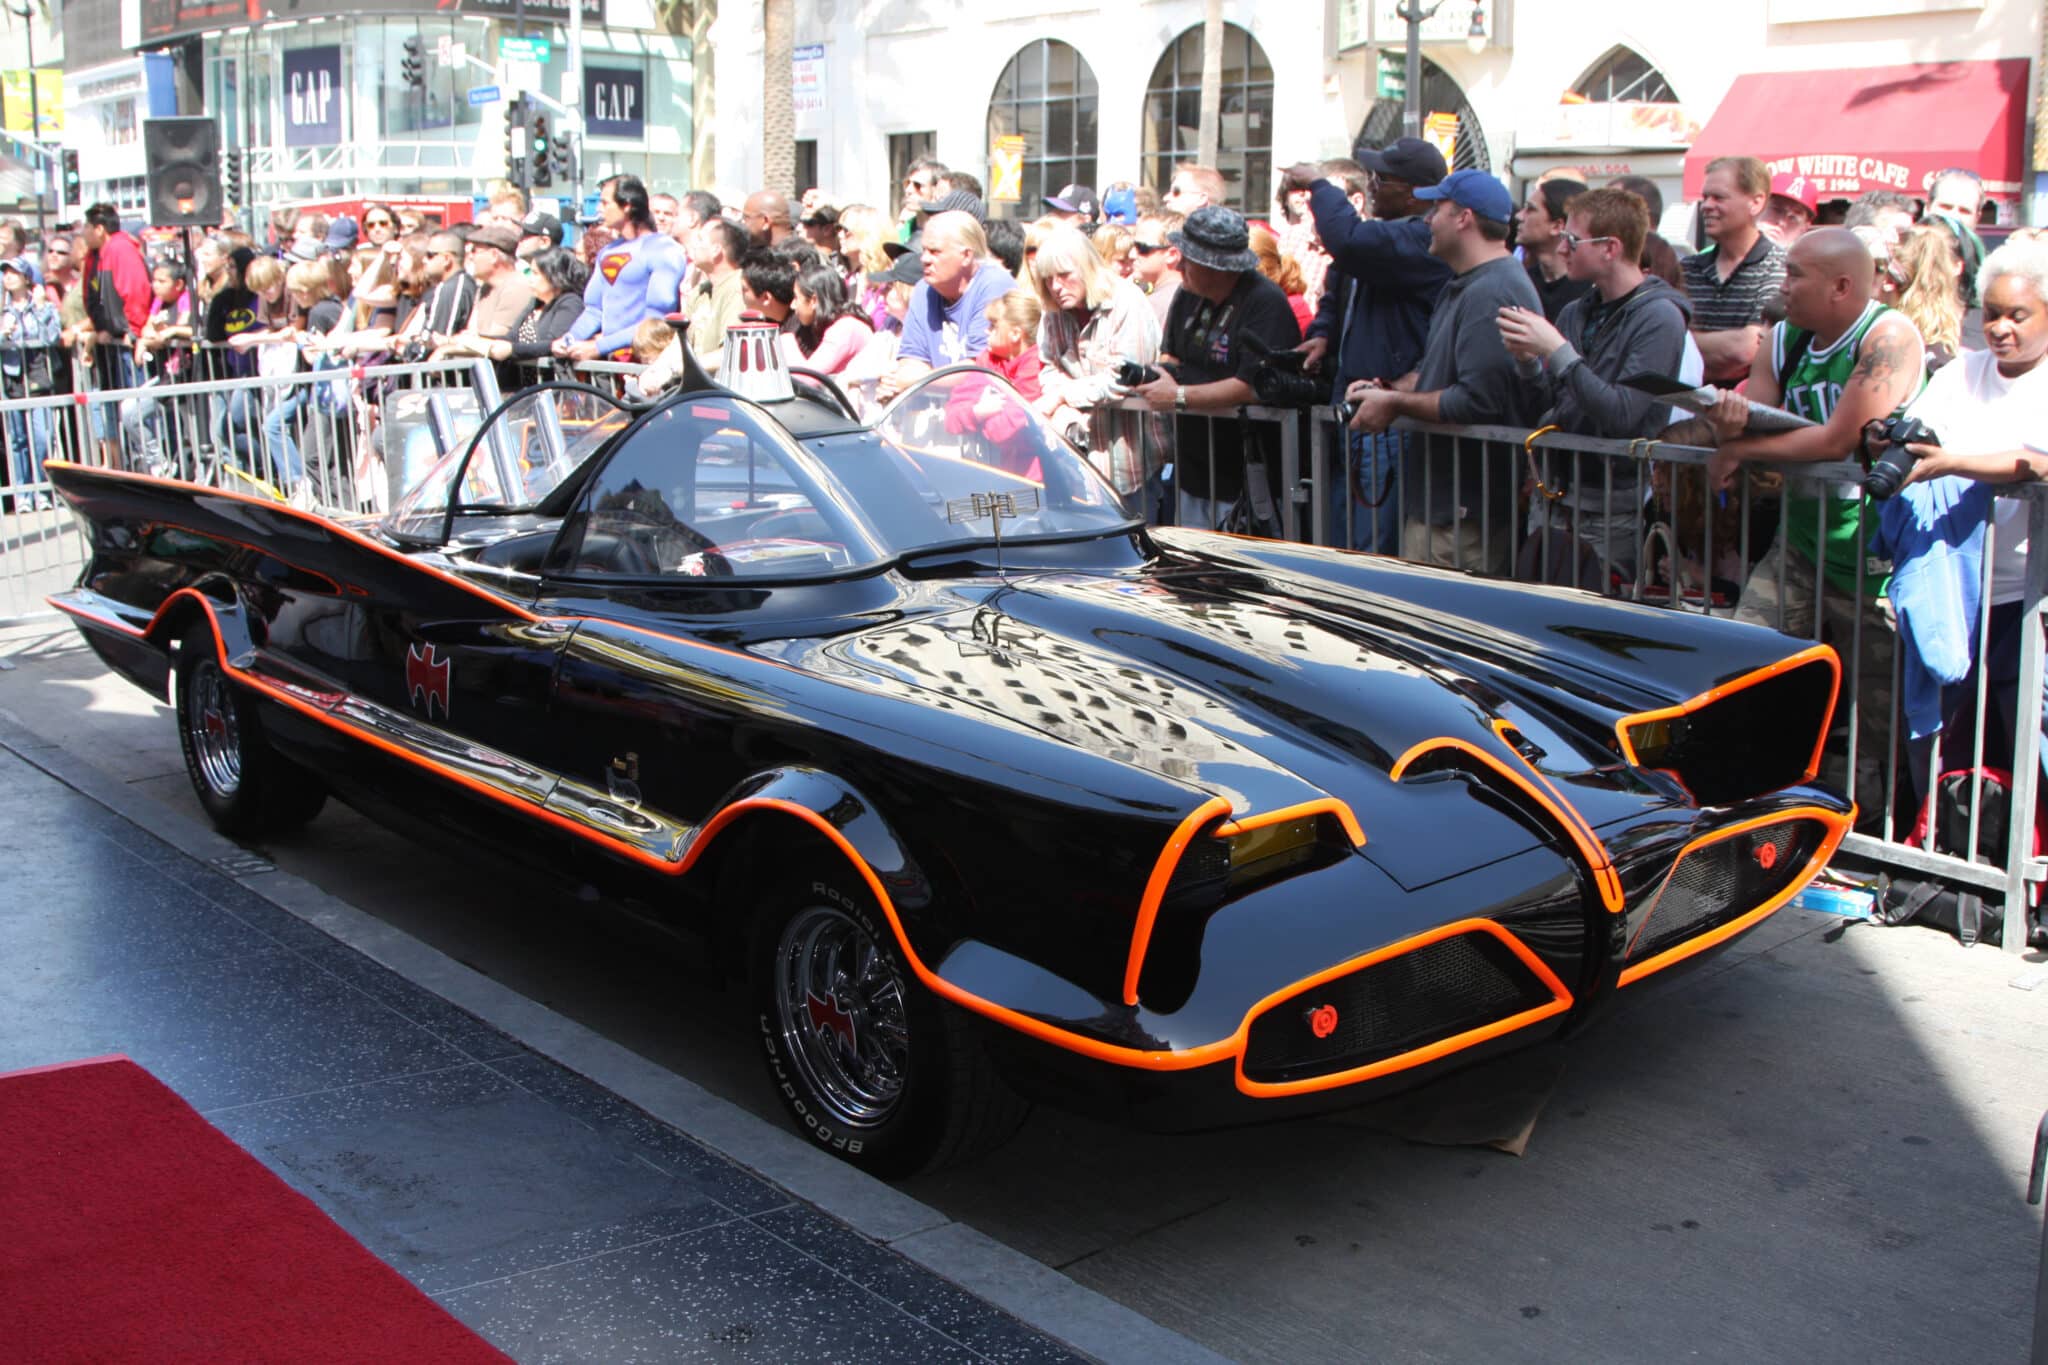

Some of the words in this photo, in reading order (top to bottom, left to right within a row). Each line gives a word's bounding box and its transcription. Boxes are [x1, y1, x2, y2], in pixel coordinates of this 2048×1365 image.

[291, 69, 331, 125] GAP
[595, 82, 635, 121] GAP
[1797, 155, 1858, 176] WHITE
[1859, 158, 1909, 188] CAFE
[811, 880, 880, 939] Radial
[759, 1013, 864, 1154] BFGoodrich
